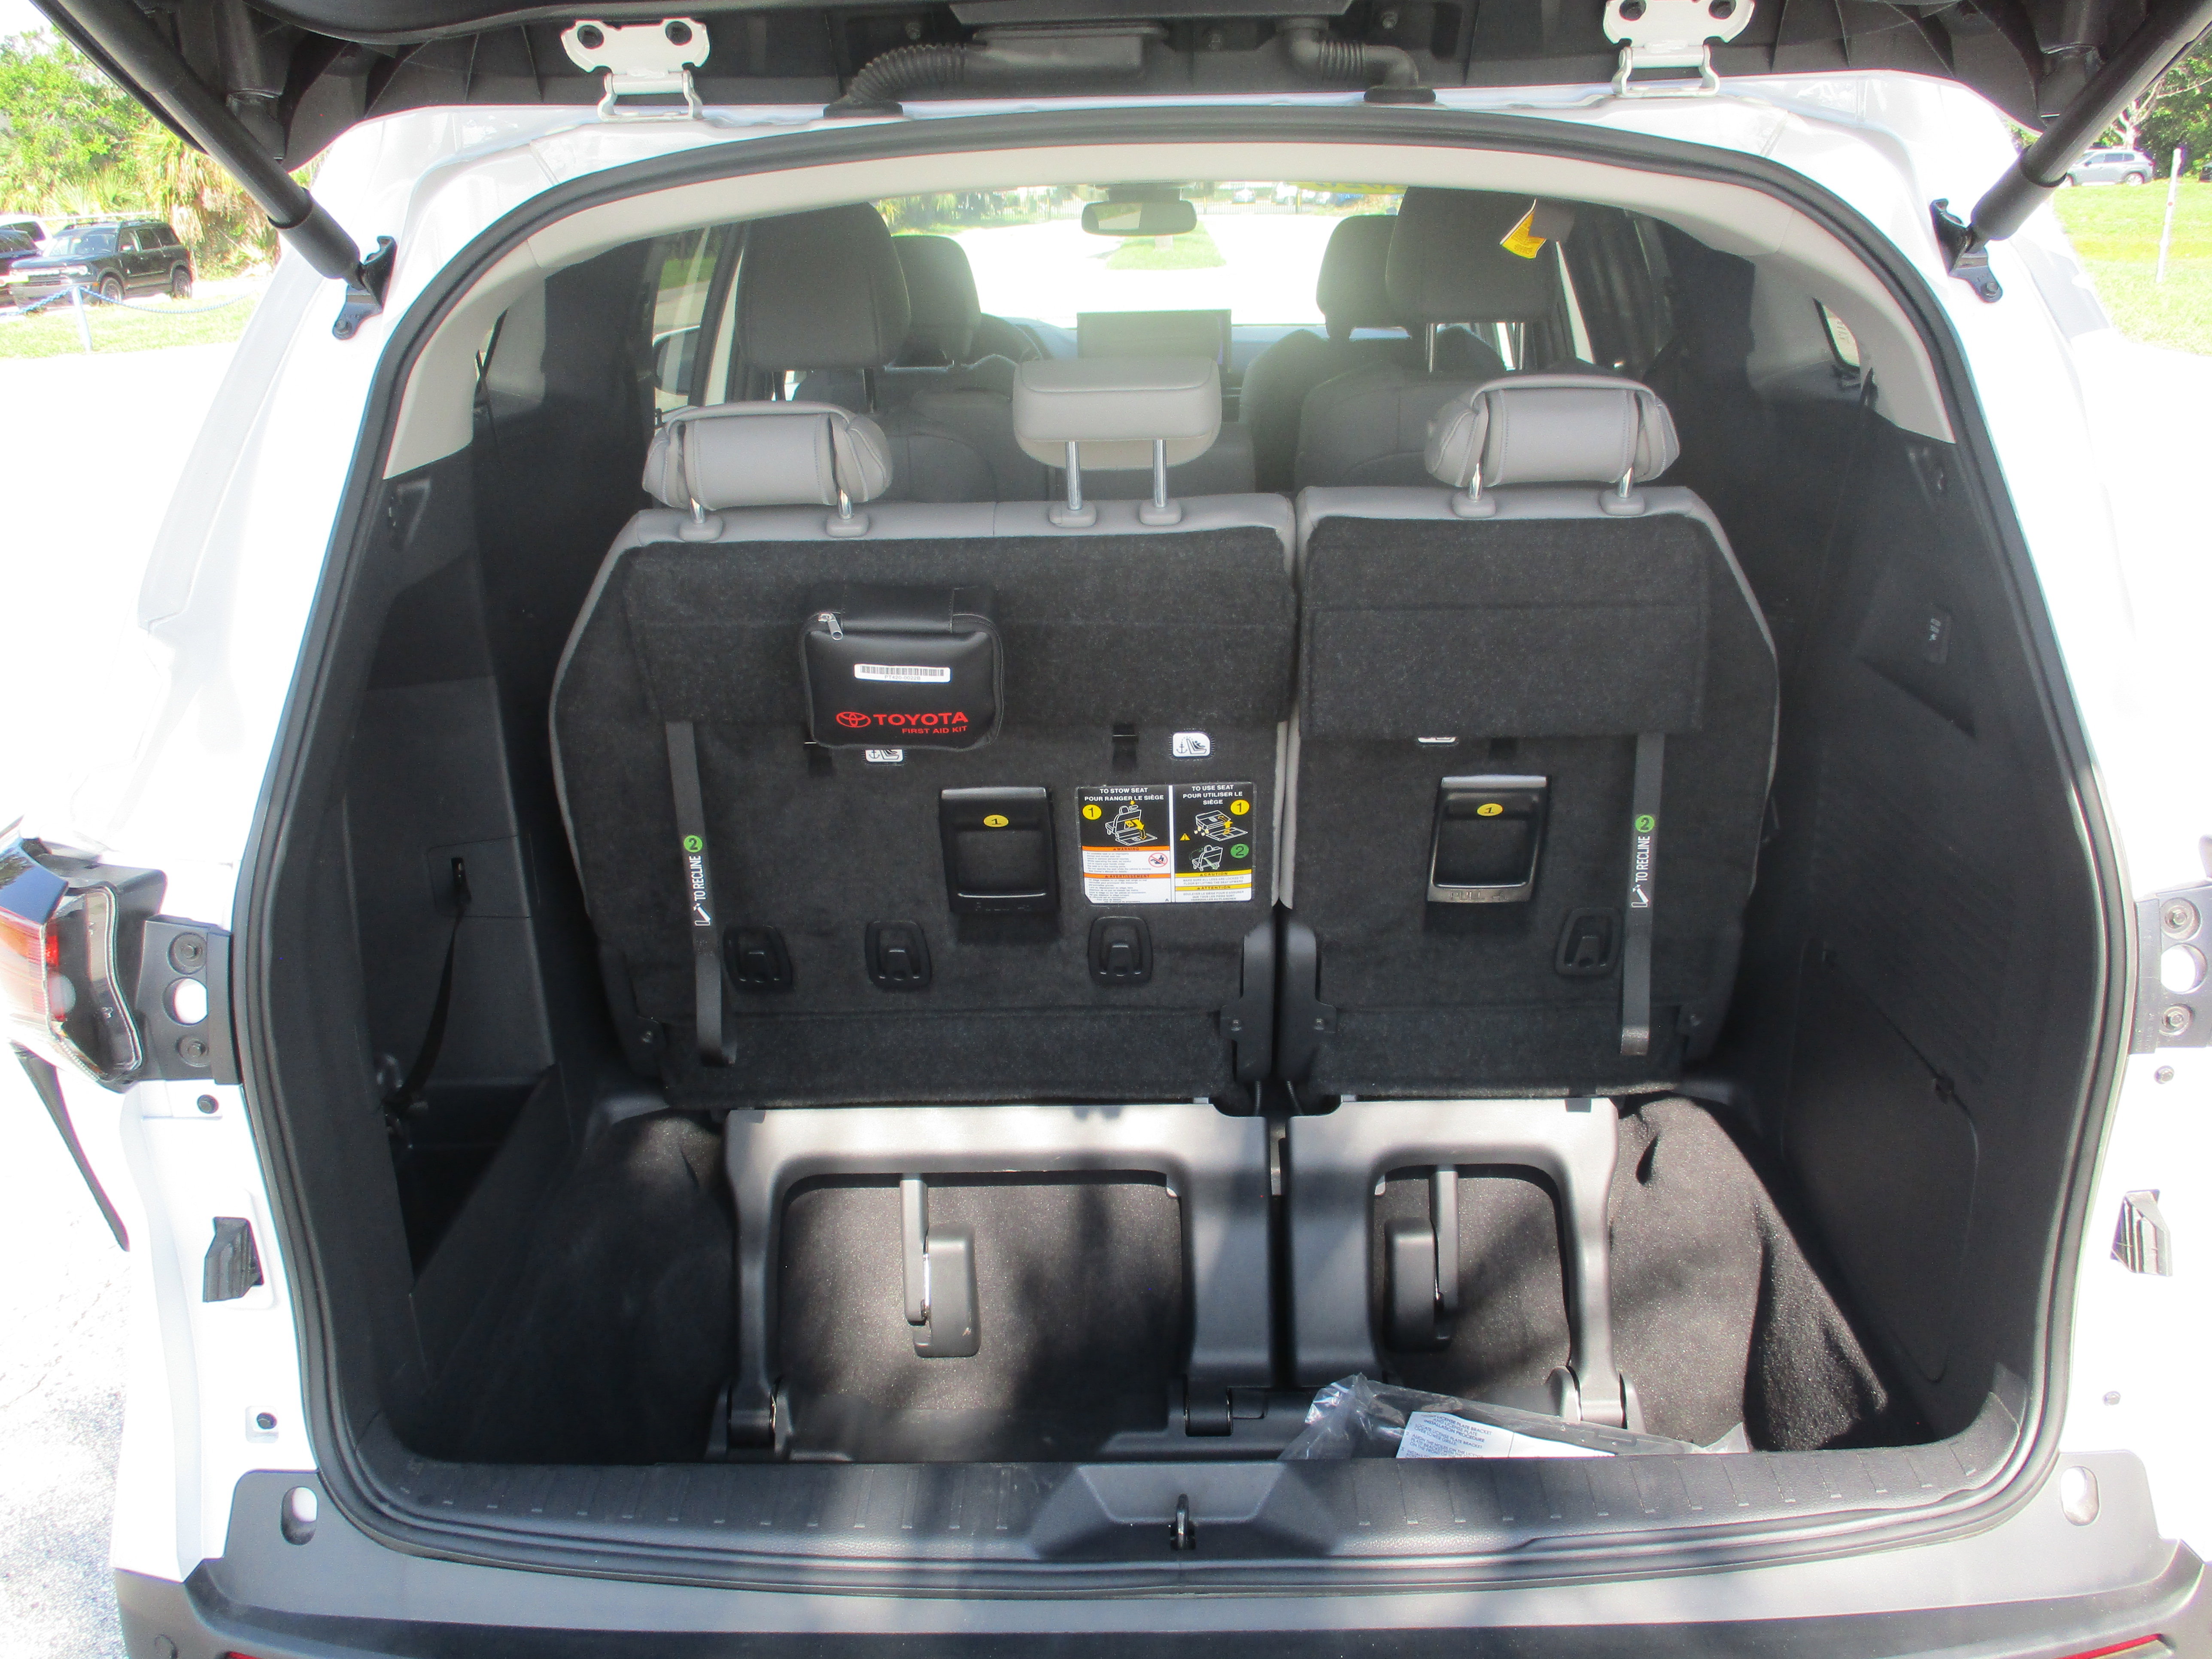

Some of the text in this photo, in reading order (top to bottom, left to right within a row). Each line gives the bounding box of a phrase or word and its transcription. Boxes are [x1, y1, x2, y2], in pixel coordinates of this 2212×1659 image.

[873, 711, 969, 726] TOYOTA
[1088, 807, 1094, 817] 1
[1237, 802, 1242, 812] 1
[1641, 817, 1649, 830] 2
[688, 838, 698, 850] 2
[1236, 846, 1244, 856] 2
[1635, 836, 1650, 882] TO RECLINE
[689, 855, 706, 901] TO RECLINE
